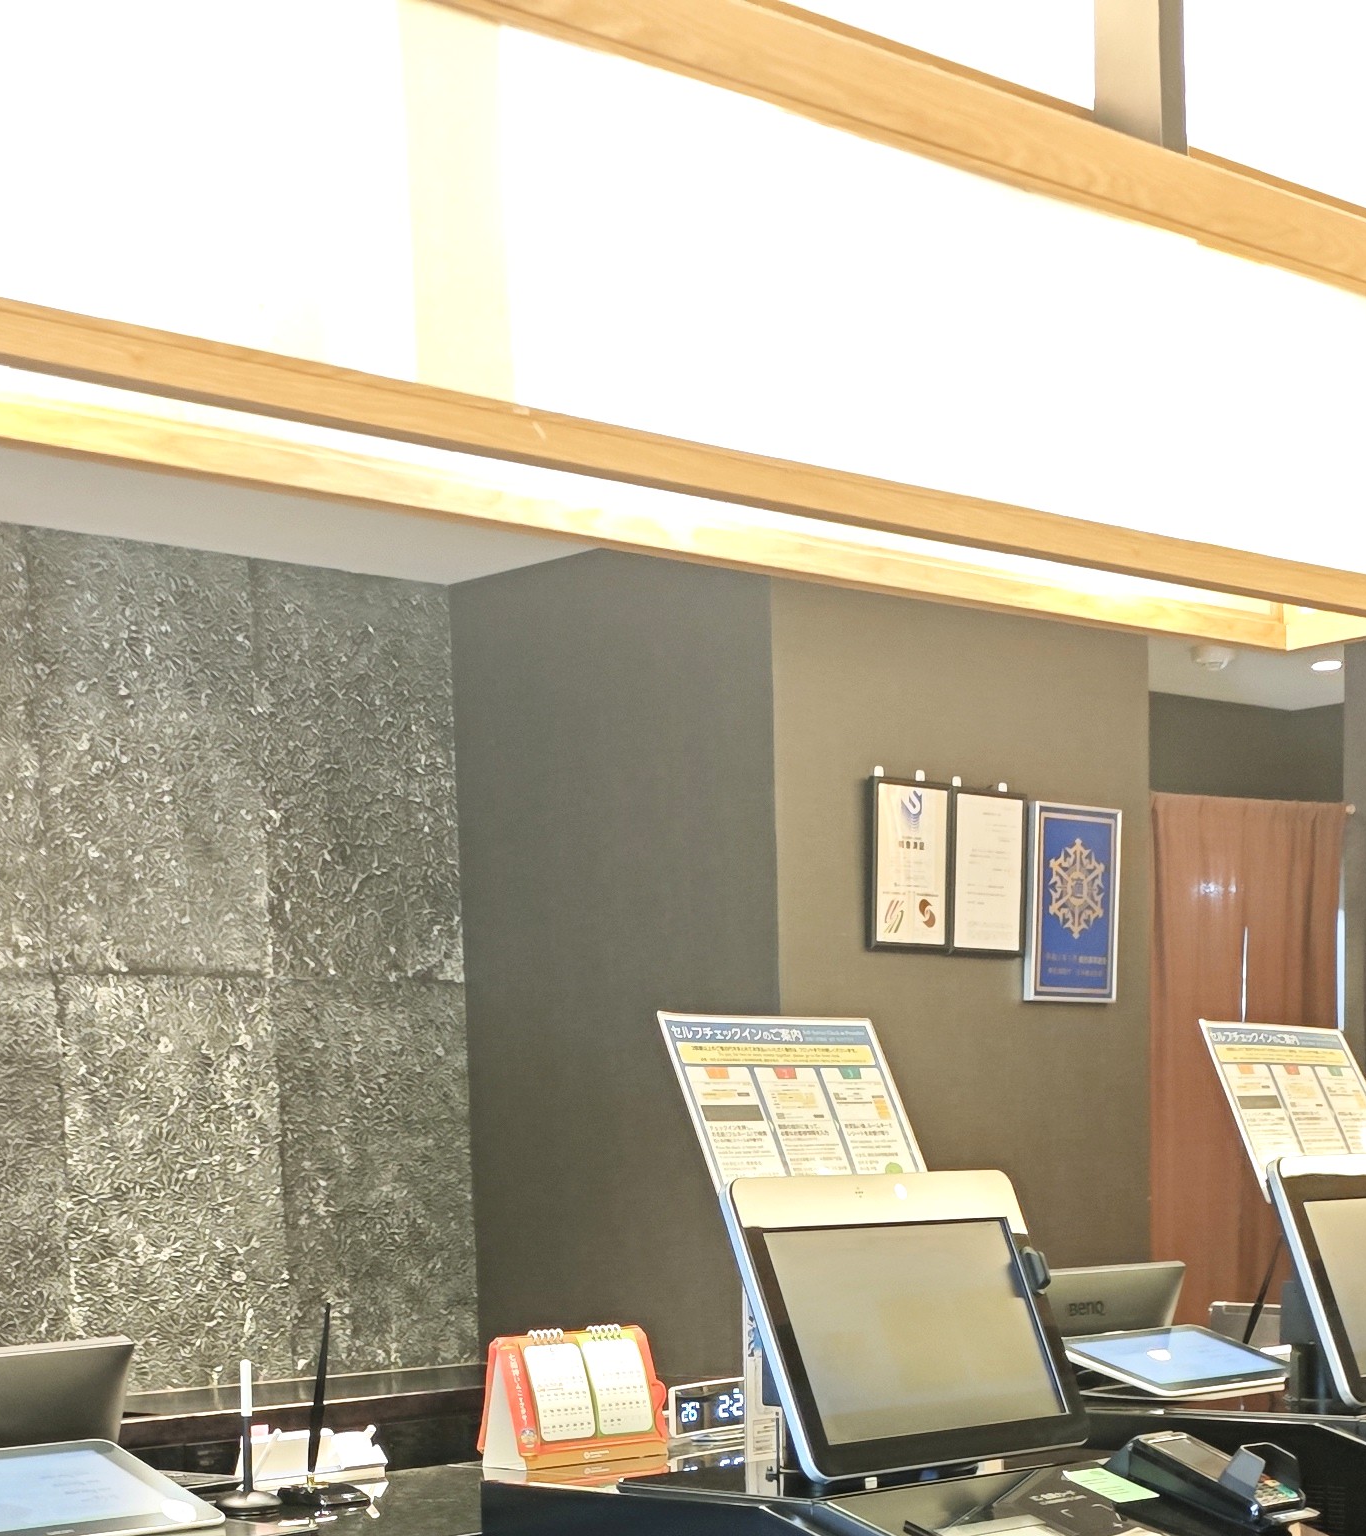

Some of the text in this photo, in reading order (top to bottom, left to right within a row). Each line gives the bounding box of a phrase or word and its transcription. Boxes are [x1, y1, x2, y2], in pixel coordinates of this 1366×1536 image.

[670, 1025, 804, 1042] セルフチェックインのご案内
[1069, 1300, 1106, 1317] BenQ
